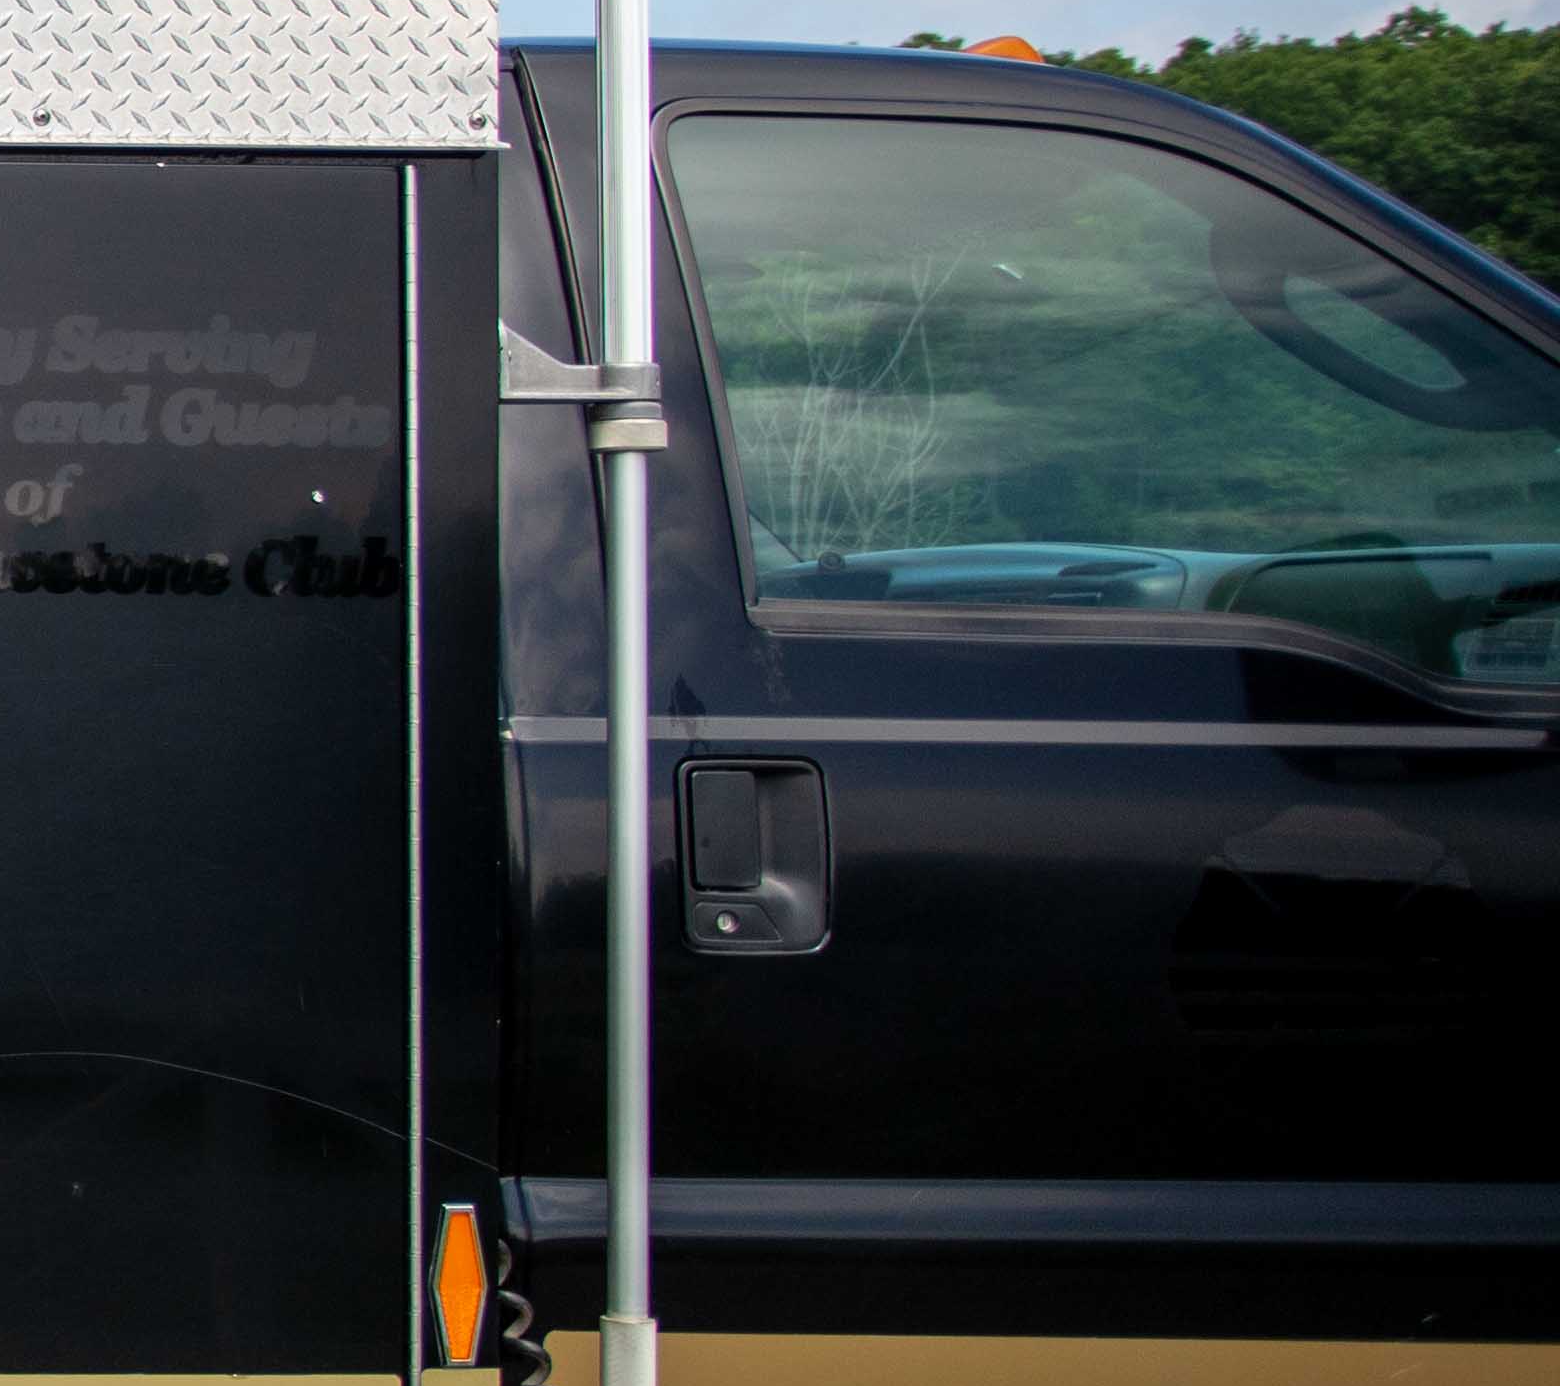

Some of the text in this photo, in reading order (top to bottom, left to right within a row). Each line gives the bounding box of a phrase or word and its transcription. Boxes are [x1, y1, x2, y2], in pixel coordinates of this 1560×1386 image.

[45, 315, 316, 388] Serving
[14, 385, 152, 444] and
[161, 387, 392, 447] Guests
[4, 465, 84, 526] of
[244, 535, 401, 598] Club
